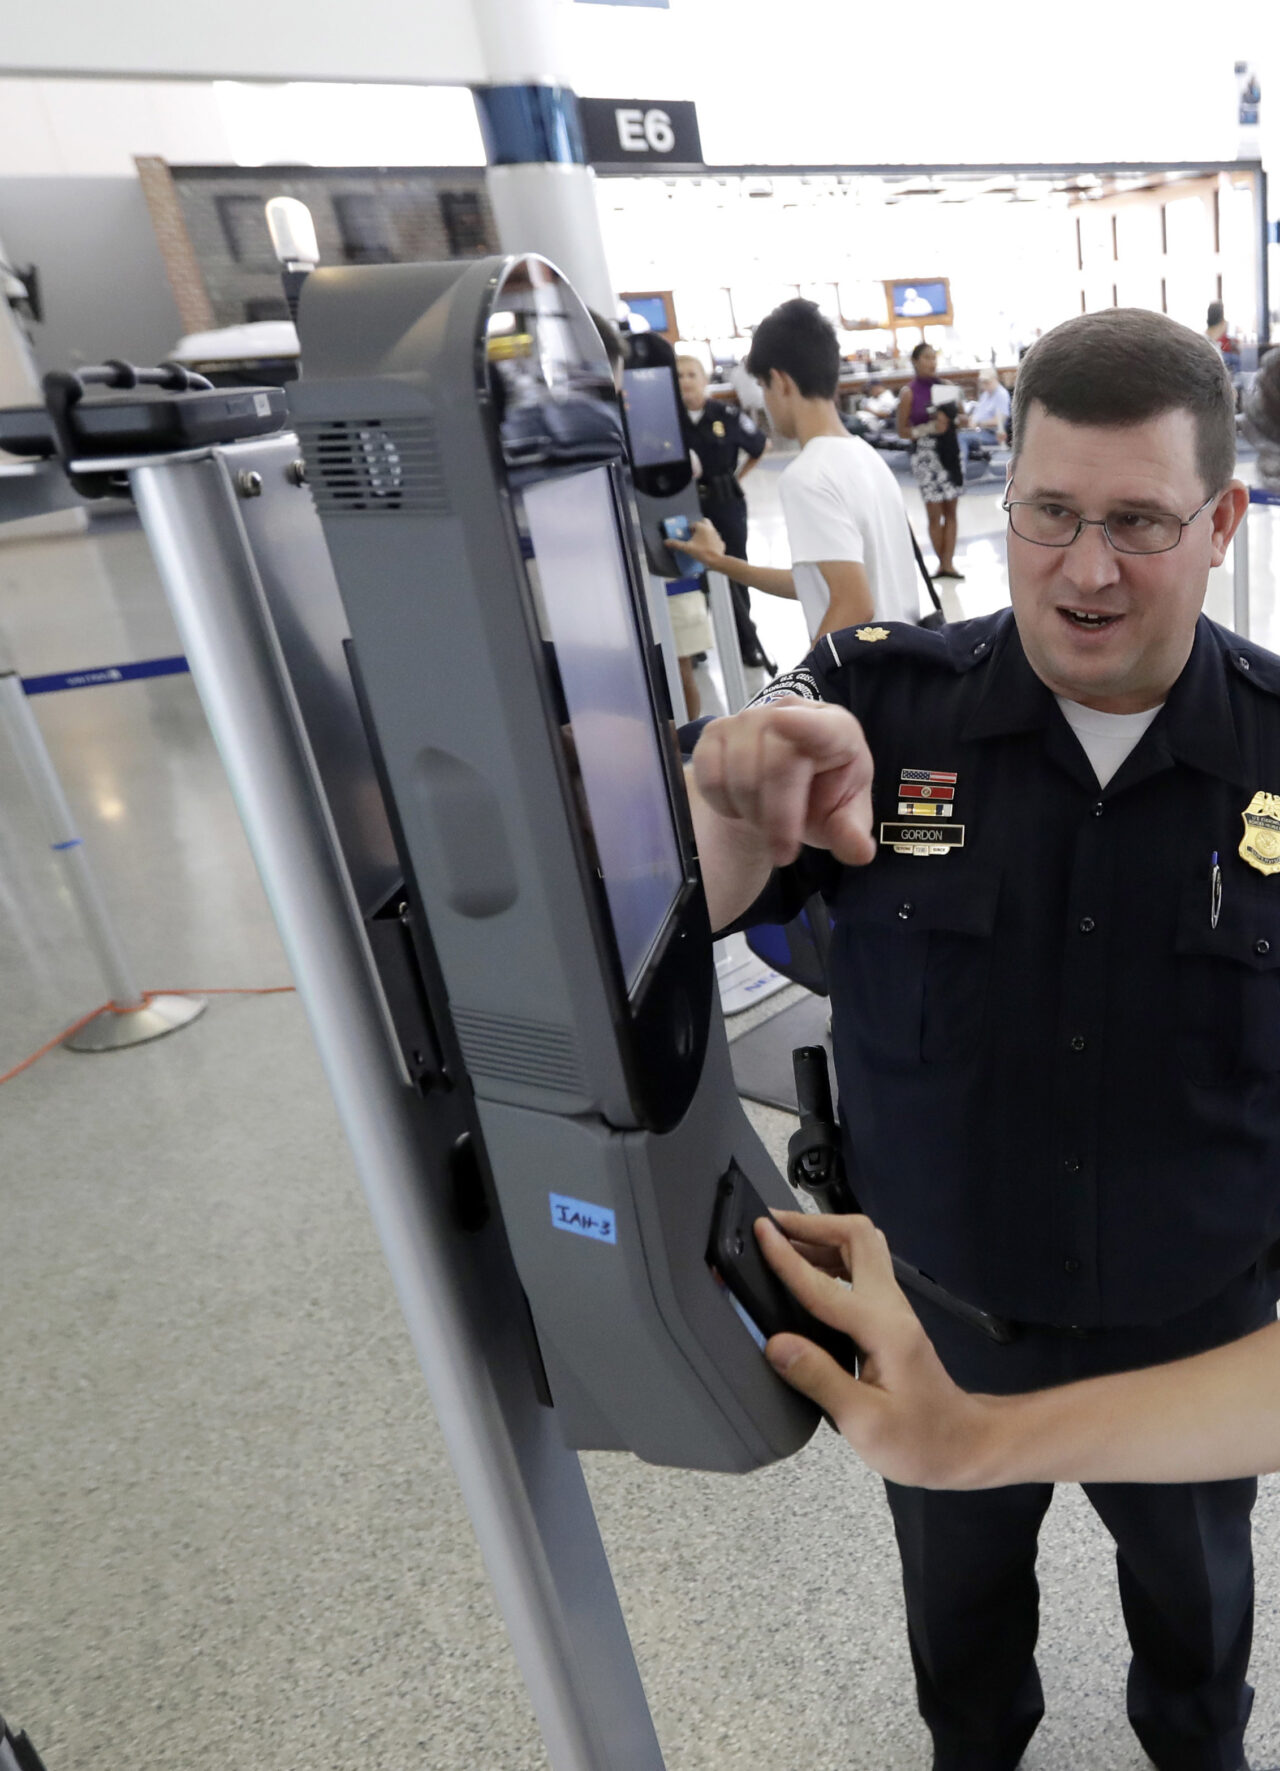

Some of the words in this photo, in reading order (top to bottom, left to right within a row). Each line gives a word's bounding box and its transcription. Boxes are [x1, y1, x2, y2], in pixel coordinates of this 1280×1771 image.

[615, 108, 675, 153] E6
[900, 829, 943, 841] GORDON
[555, 1204, 611, 1235] IAH-3
